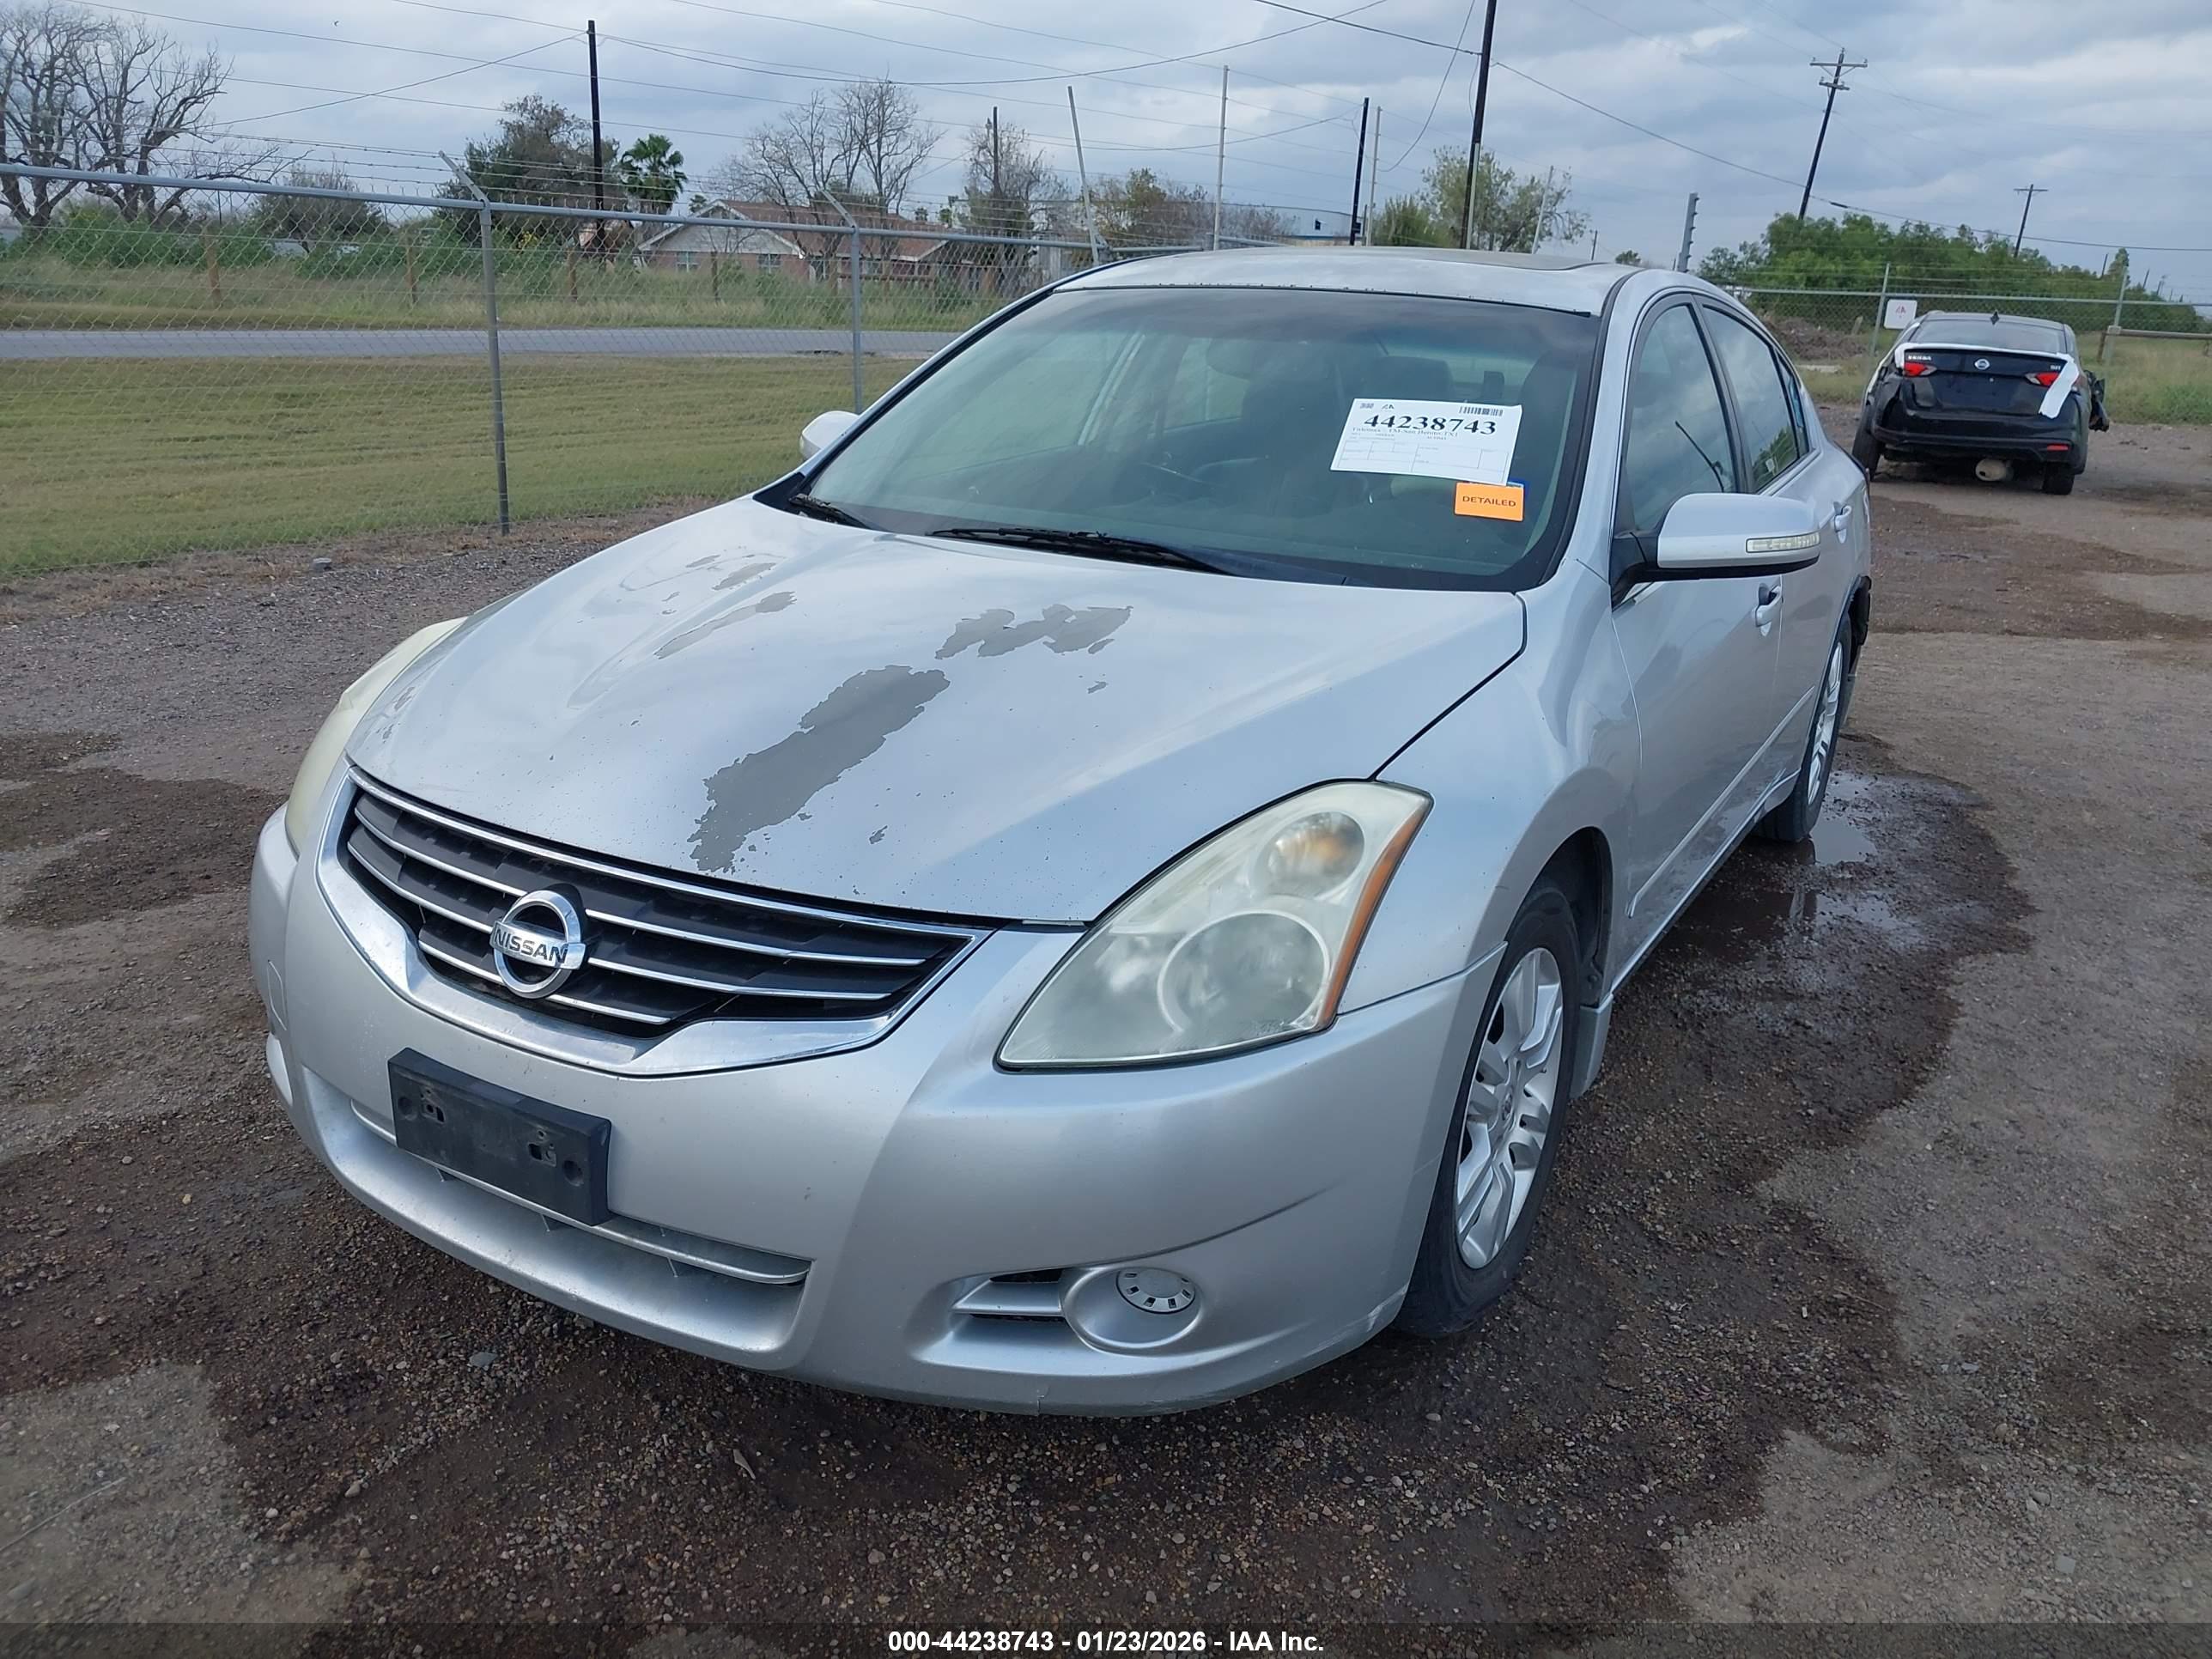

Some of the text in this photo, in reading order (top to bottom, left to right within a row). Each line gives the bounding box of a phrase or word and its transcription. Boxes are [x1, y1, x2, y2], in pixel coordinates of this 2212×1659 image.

[1364, 414, 1497, 435] 44238743
[1462, 495, 1516, 507] DETAILED
[494, 928, 568, 963] NISSAN
